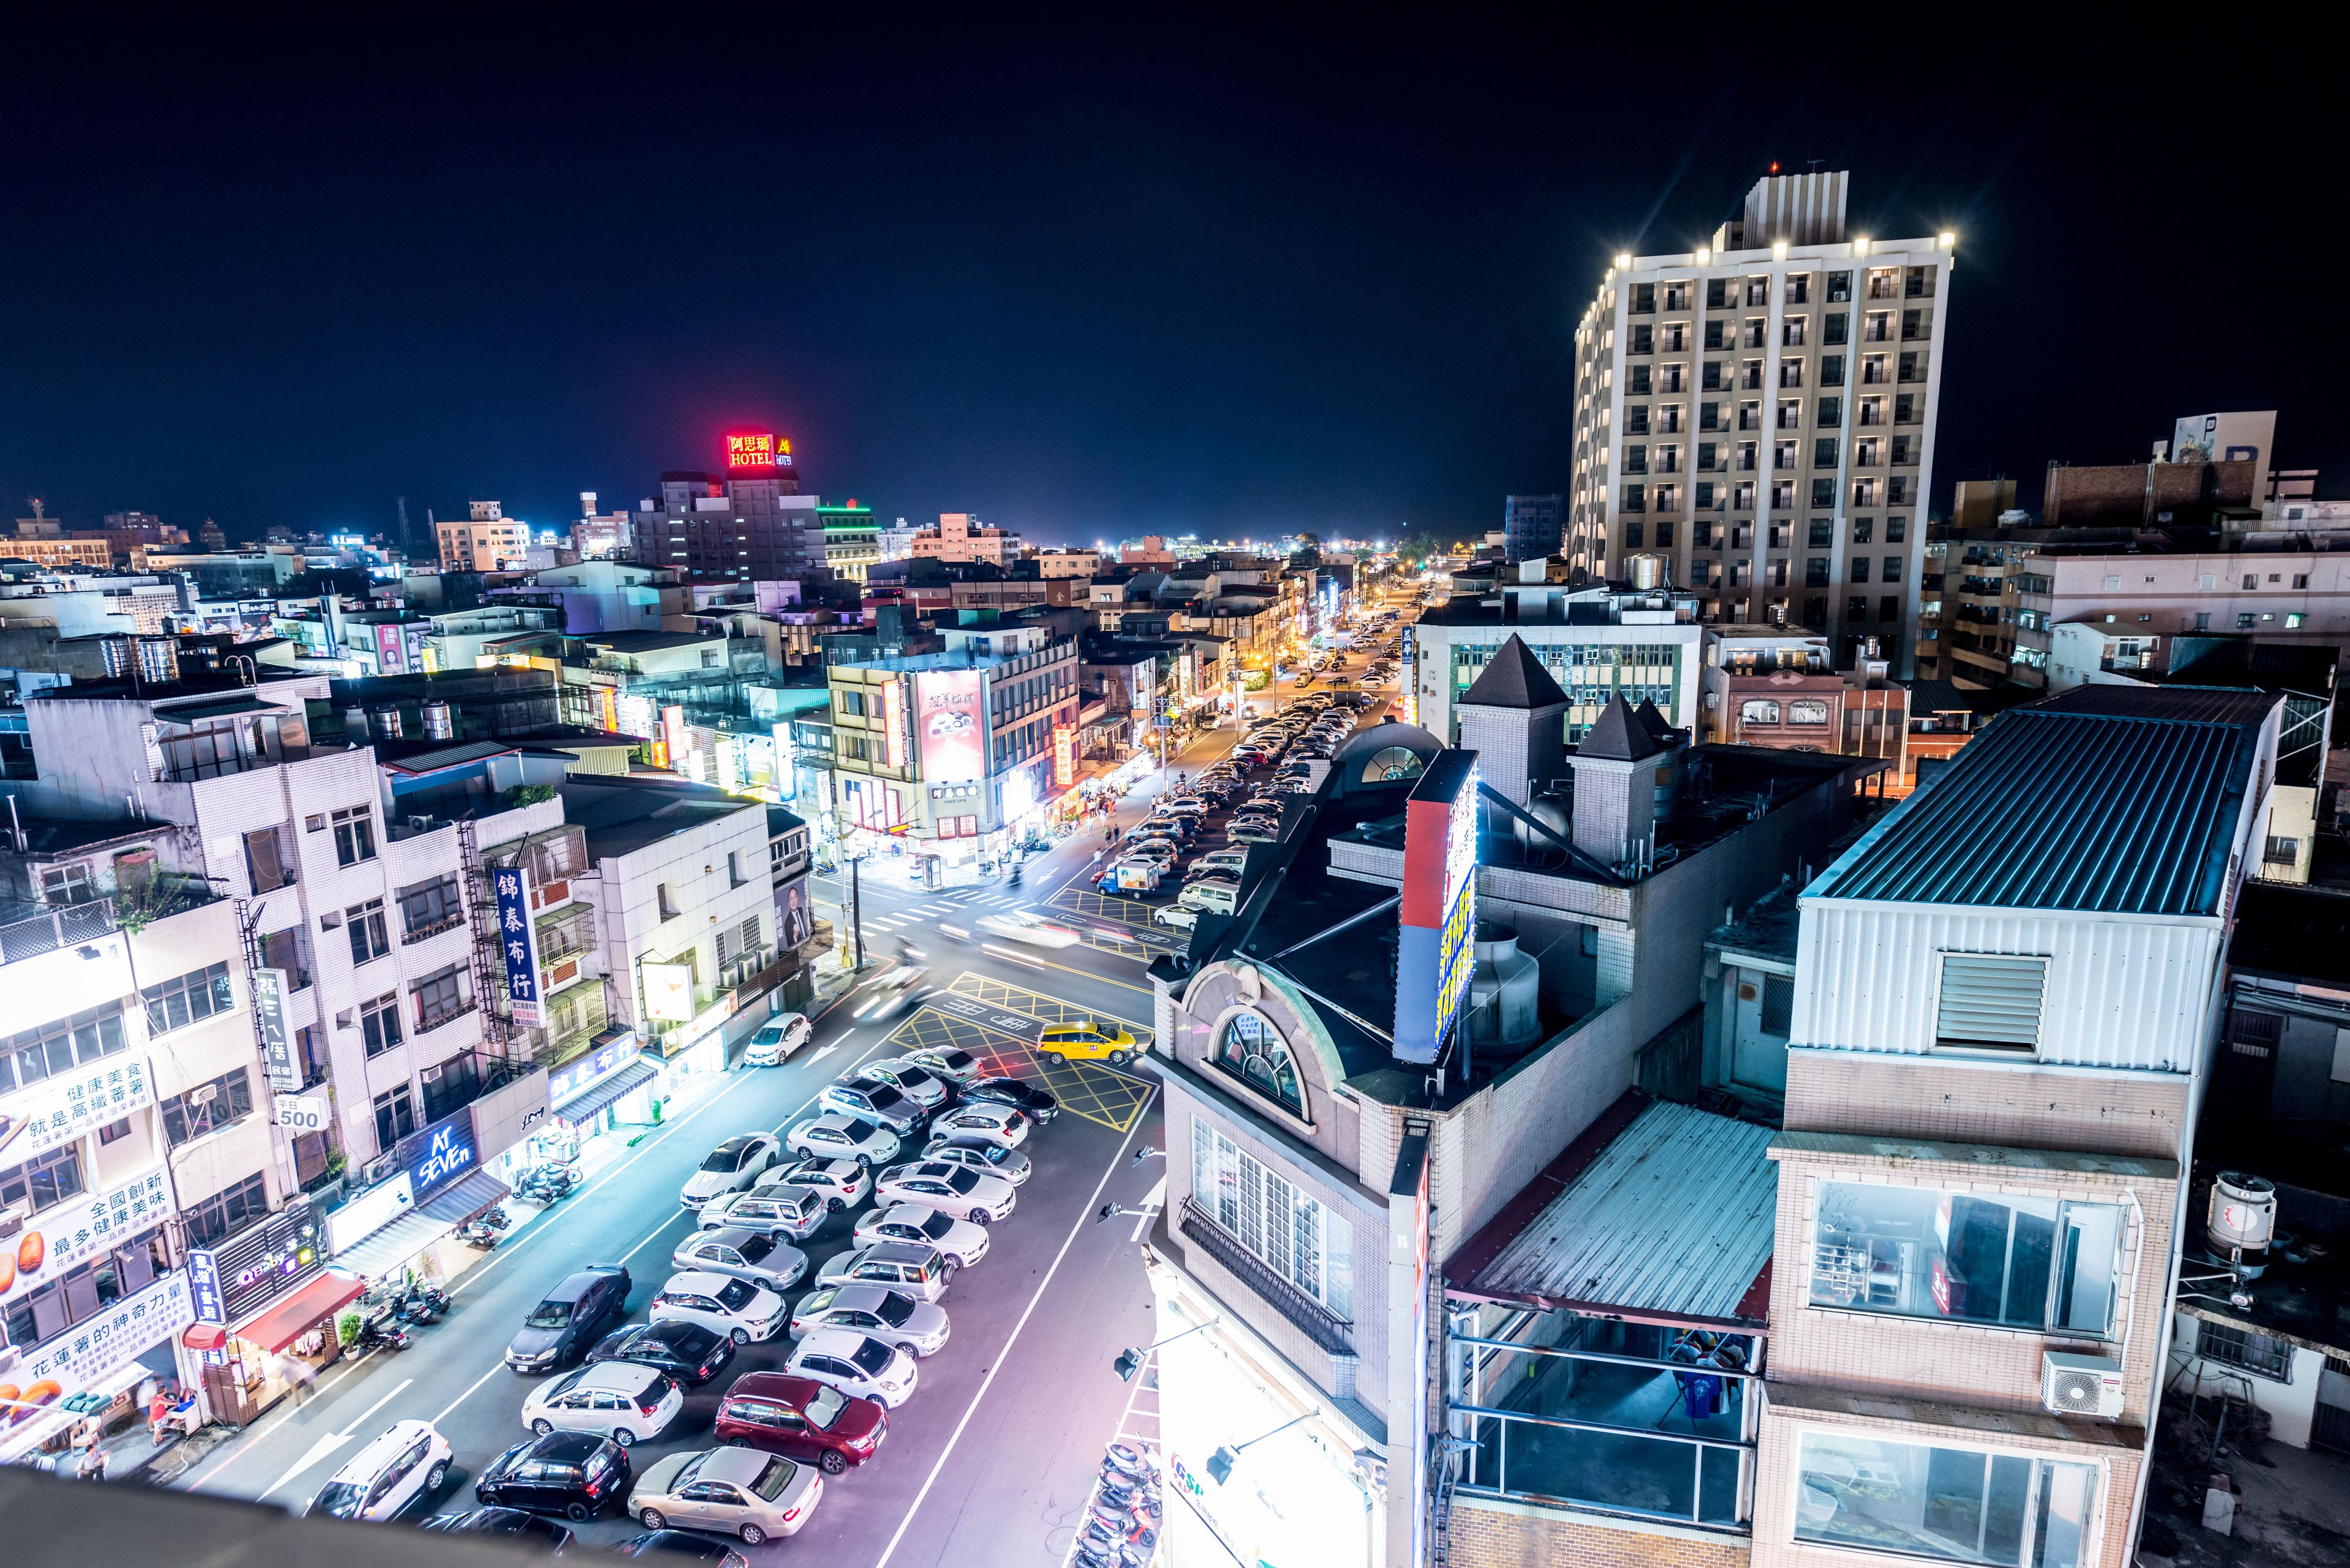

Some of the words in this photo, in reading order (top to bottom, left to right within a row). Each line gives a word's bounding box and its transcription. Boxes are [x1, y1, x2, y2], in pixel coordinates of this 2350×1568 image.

[730, 436, 770, 452] 阿思瑪
[731, 452, 772, 465] HOTEL
[775, 455, 792, 465] HOTEL
[1403, 630, 1412, 655] 益華
[498, 874, 531, 998] 錦泰布行
[67, 1062, 141, 1102] 健康美食
[272, 1066, 291, 1075] 民宿
[278, 1099, 297, 1110] 平日
[280, 1110, 318, 1127] 500
[431, 1126, 452, 1157] AT
[91, 1173, 162, 1219] 全國創新
[54, 1192, 165, 1256] 最多健康美味
[31, 1282, 184, 1379] 花蓮薯的神奇力量
[1176, 1462, 1204, 1496] GSP
